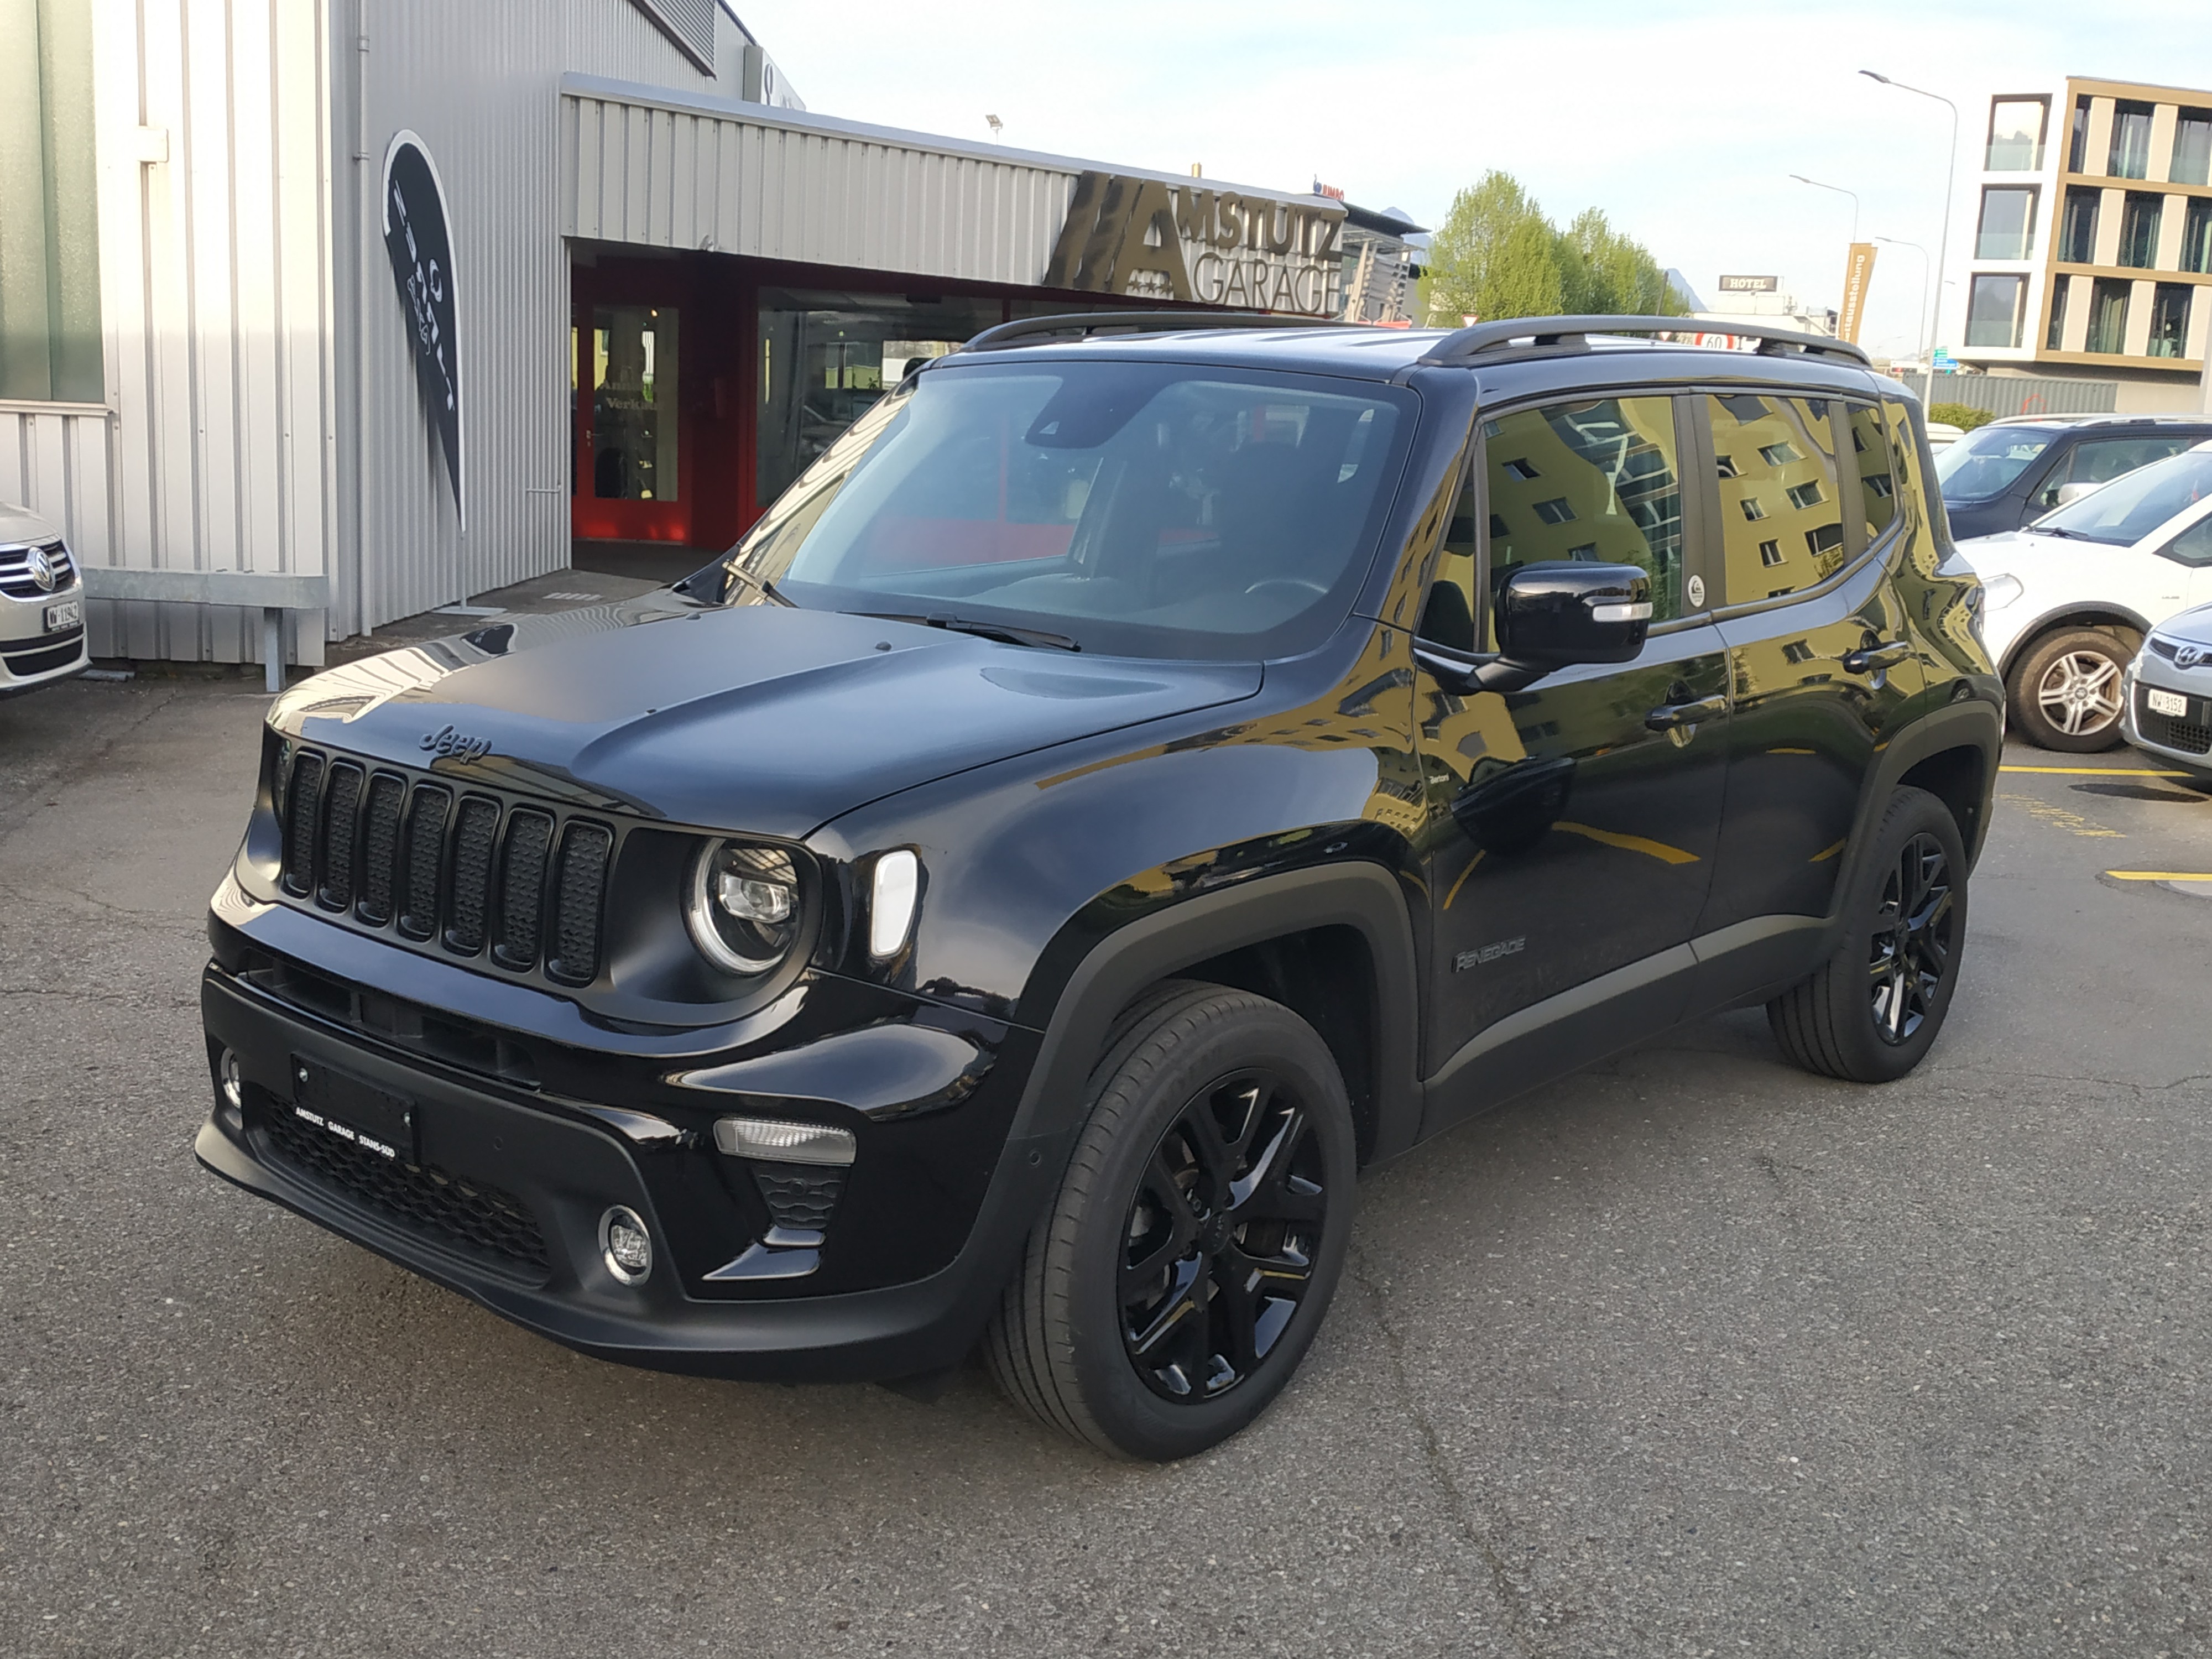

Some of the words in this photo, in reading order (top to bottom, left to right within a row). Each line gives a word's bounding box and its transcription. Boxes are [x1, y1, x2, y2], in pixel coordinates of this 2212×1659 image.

[1108, 179, 1344, 301] AMSTUTZ
[1193, 252, 1343, 319] GARAGE
[1730, 278, 1766, 289] HOTEL
[1707, 336, 1723, 349] 60
[2152, 692, 2162, 707] NW
[2166, 696, 2183, 713] 3152
[419, 723, 493, 765] Jeep
[1451, 935, 1526, 973] RENEGADE
[295, 1107, 324, 1126] AMSTUTZ
[327, 1121, 355, 1140] GARAGE
